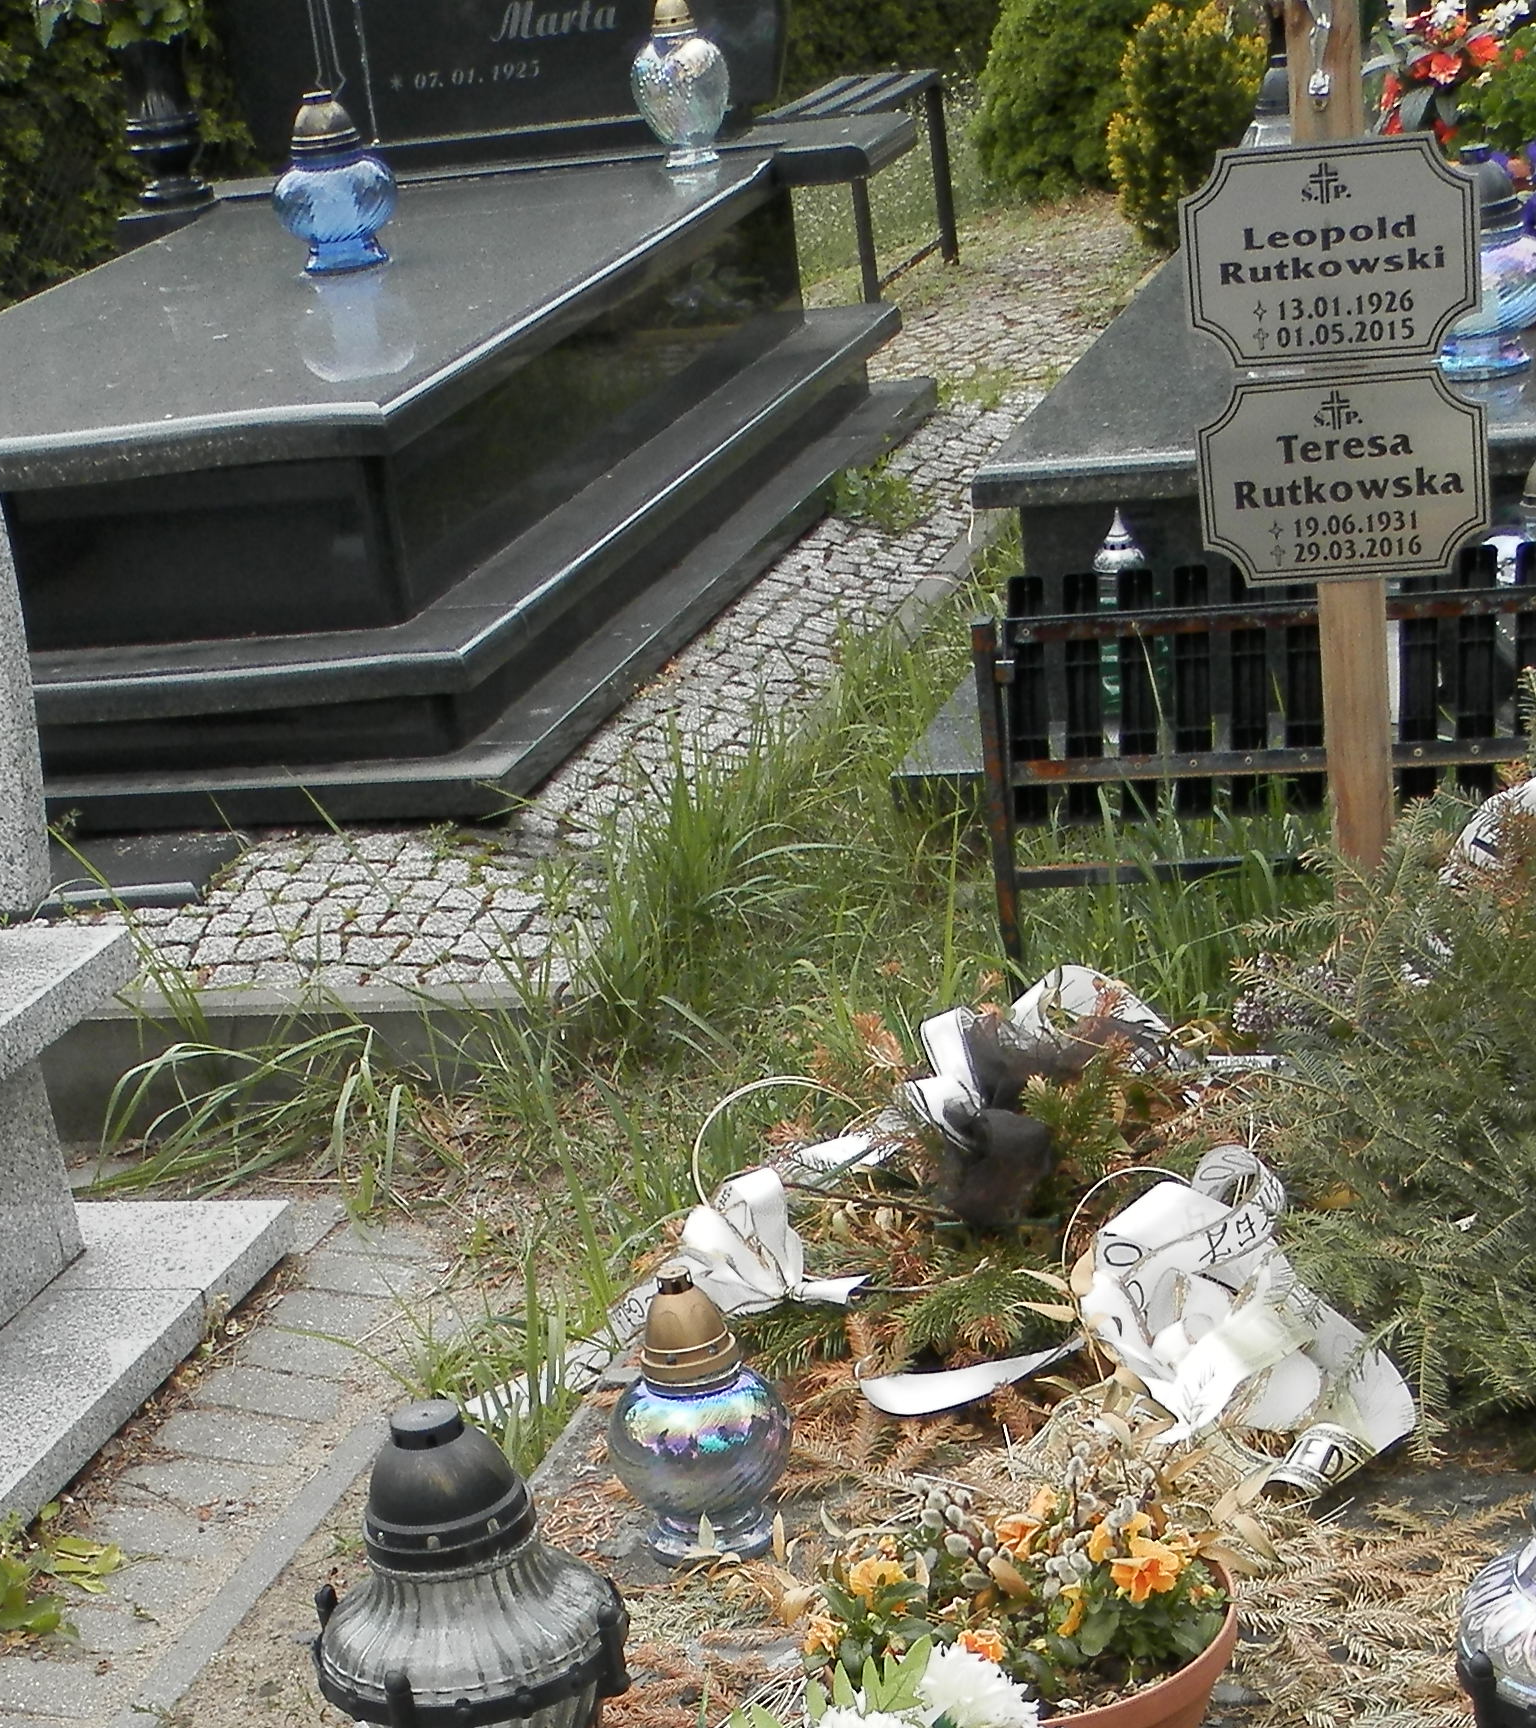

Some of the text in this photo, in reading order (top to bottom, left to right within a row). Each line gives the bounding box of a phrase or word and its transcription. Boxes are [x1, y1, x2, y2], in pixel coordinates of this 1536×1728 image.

[490, 0, 617, 42] Marta
[1243, 214, 1416, 251] Leopold
[1219, 245, 1445, 285] Rutkowski
[1278, 289, 1414, 321] 13.01.1926
[1276, 318, 1415, 348] 01.05.2015
[1276, 433, 1413, 464] Teresa
[1233, 467, 1464, 510] Rutkowska
[1294, 510, 1417, 538] 19.06.1931
[1294, 535, 1422, 563] 29.03.2016
